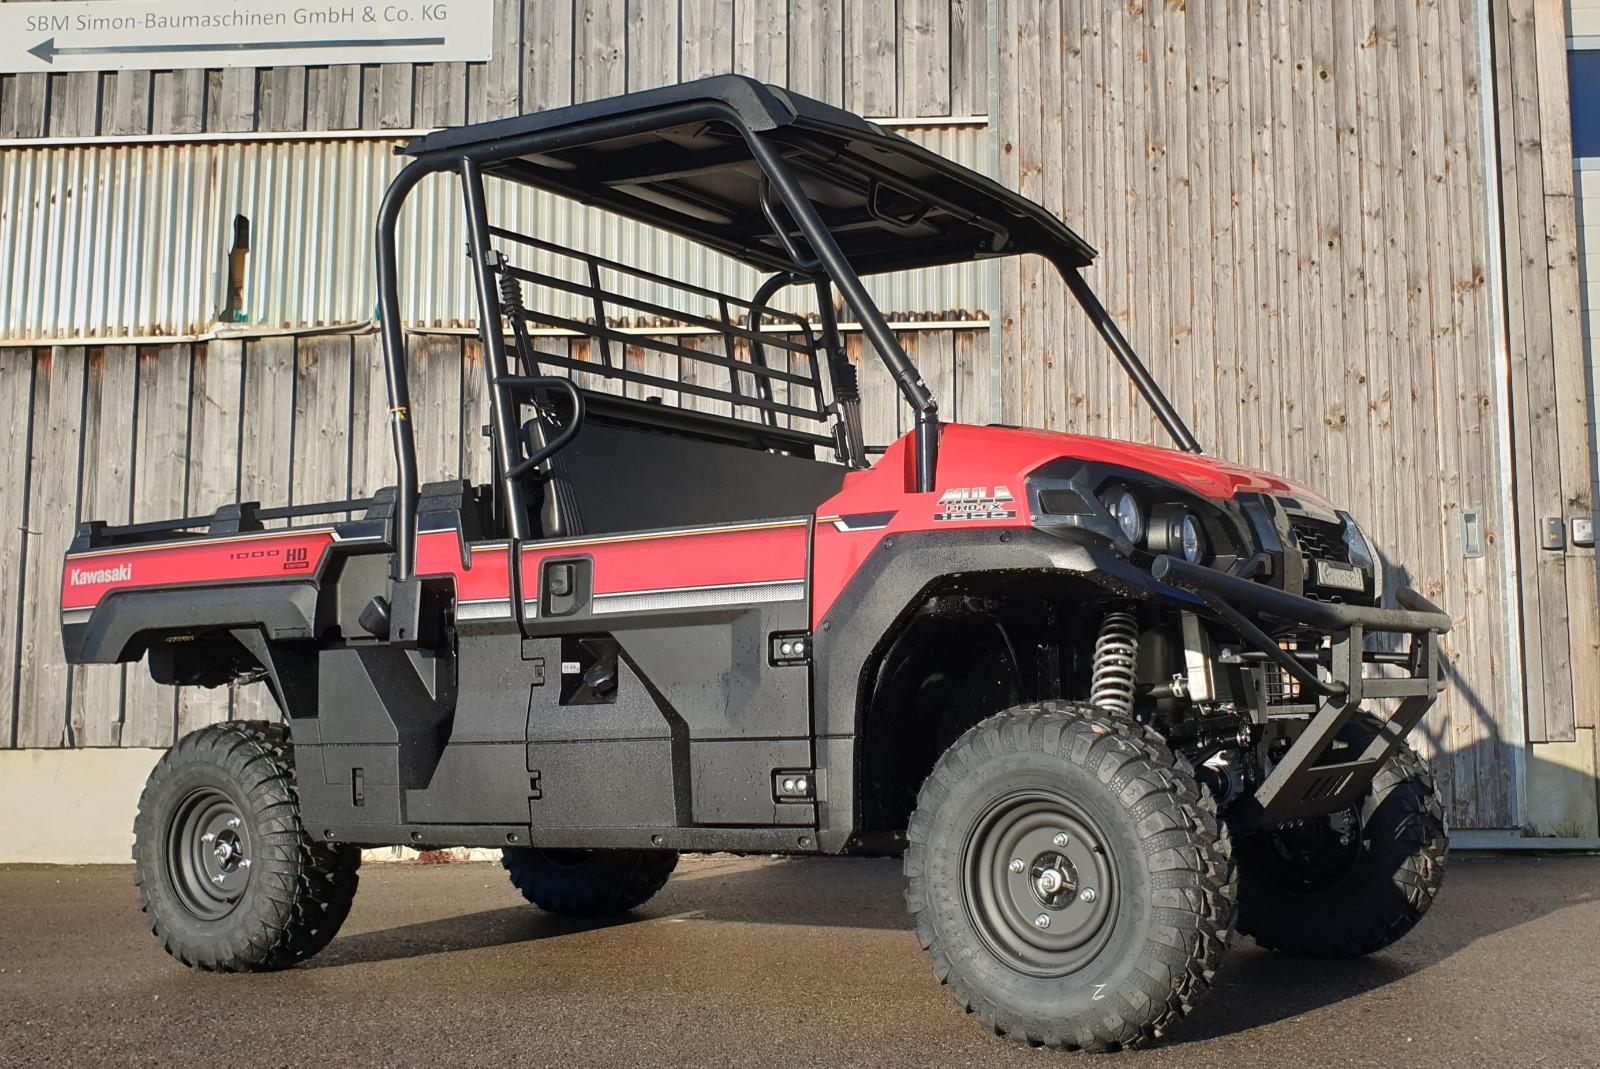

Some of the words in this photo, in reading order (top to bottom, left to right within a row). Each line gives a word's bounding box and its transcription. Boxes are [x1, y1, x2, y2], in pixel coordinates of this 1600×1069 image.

[26, 15, 70, 32] SBM
[76, 9, 287, 31] Simon-Baumaschinen
[293, 6, 355, 25] GmbH
[361, 5, 377, 23] &
[383, 5, 414, 22] Co.
[422, 4, 448, 21] KG
[230, 549, 279, 560] 1000
[286, 547, 308, 562] HD
[70, 562, 133, 587] Kawasaki
